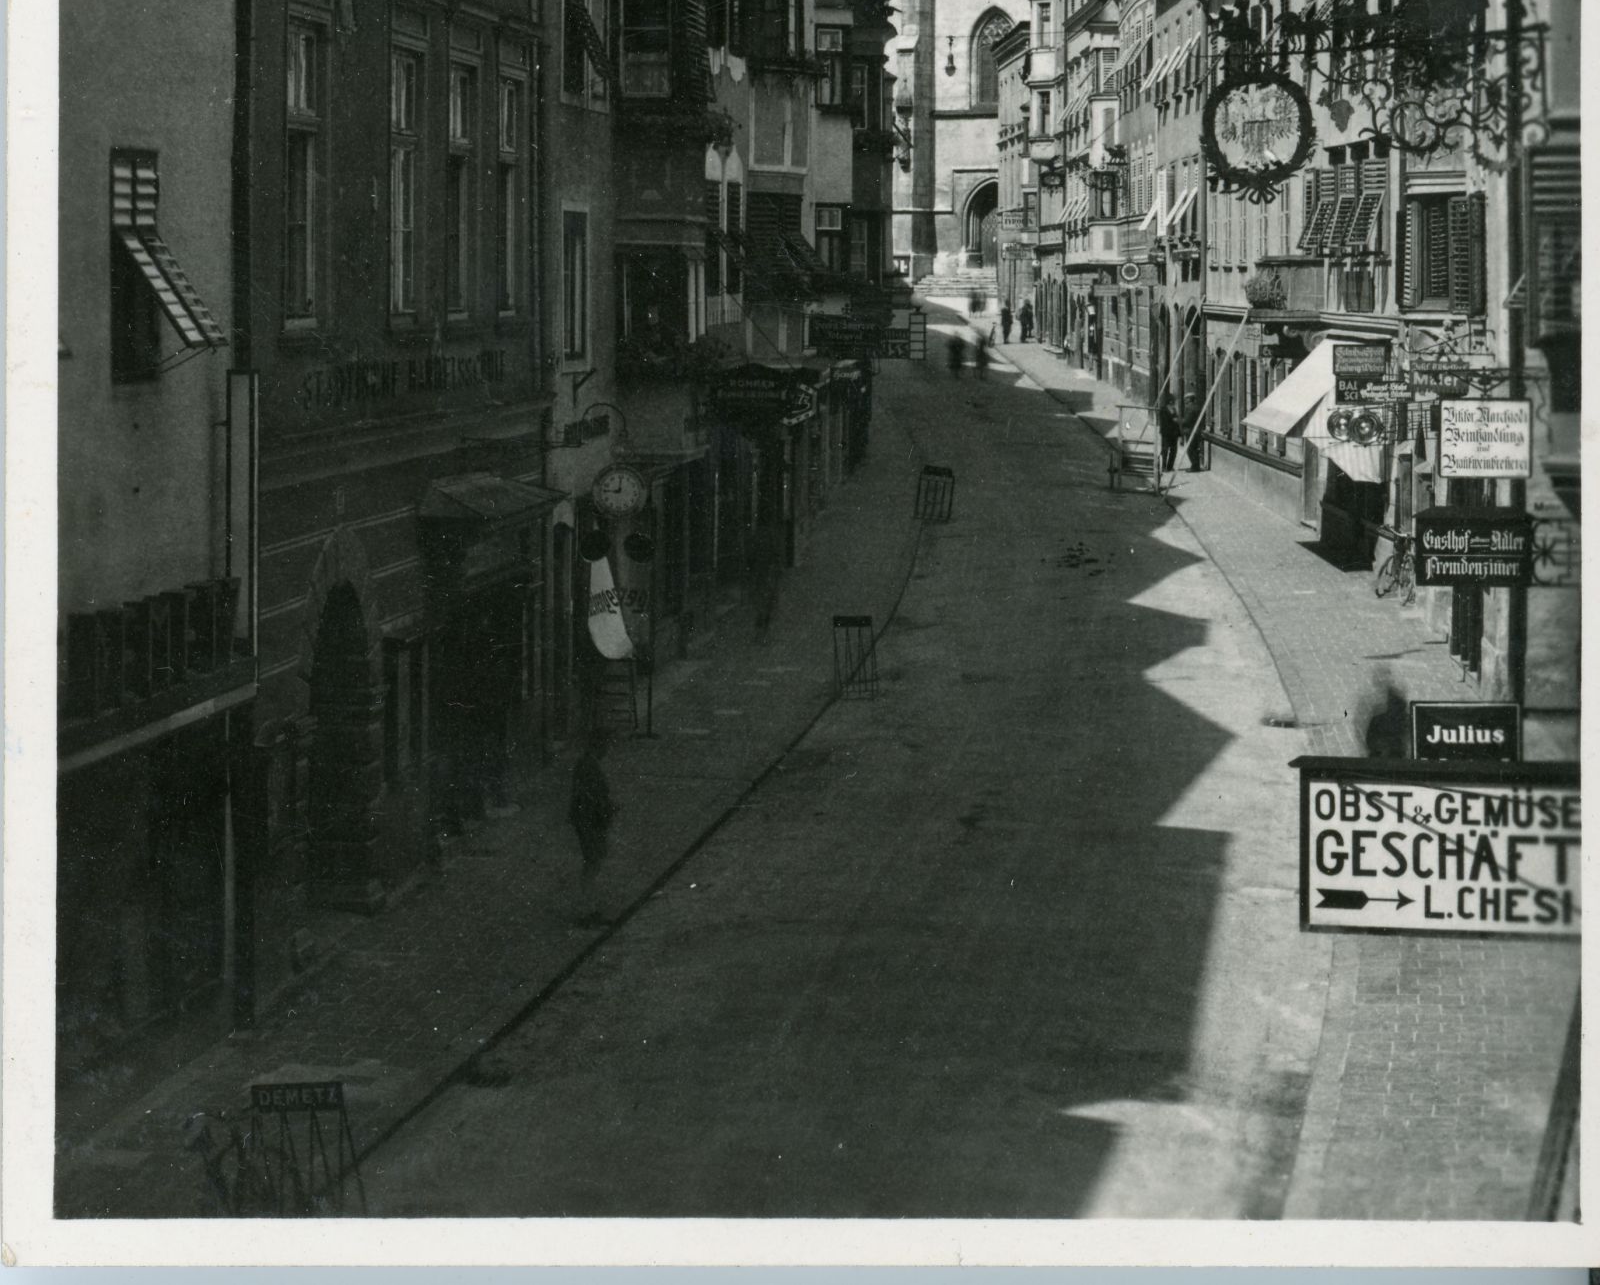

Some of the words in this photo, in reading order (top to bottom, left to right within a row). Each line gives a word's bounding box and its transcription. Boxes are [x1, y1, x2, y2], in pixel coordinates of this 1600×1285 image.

[1445, 427, 1525, 446] Weinhandlung
[1422, 528, 1471, 553] Gasthof
[1490, 529, 1525, 551] Adler
[1426, 724, 1505, 745] Julius
[1315, 789, 1413, 823] OBST
[1412, 804, 1433, 825] &
[1434, 787, 1581, 830] GEMÜSE
[1315, 828, 1581, 885] GESCHÄFT
[258, 1087, 338, 1106] DEMETZ
